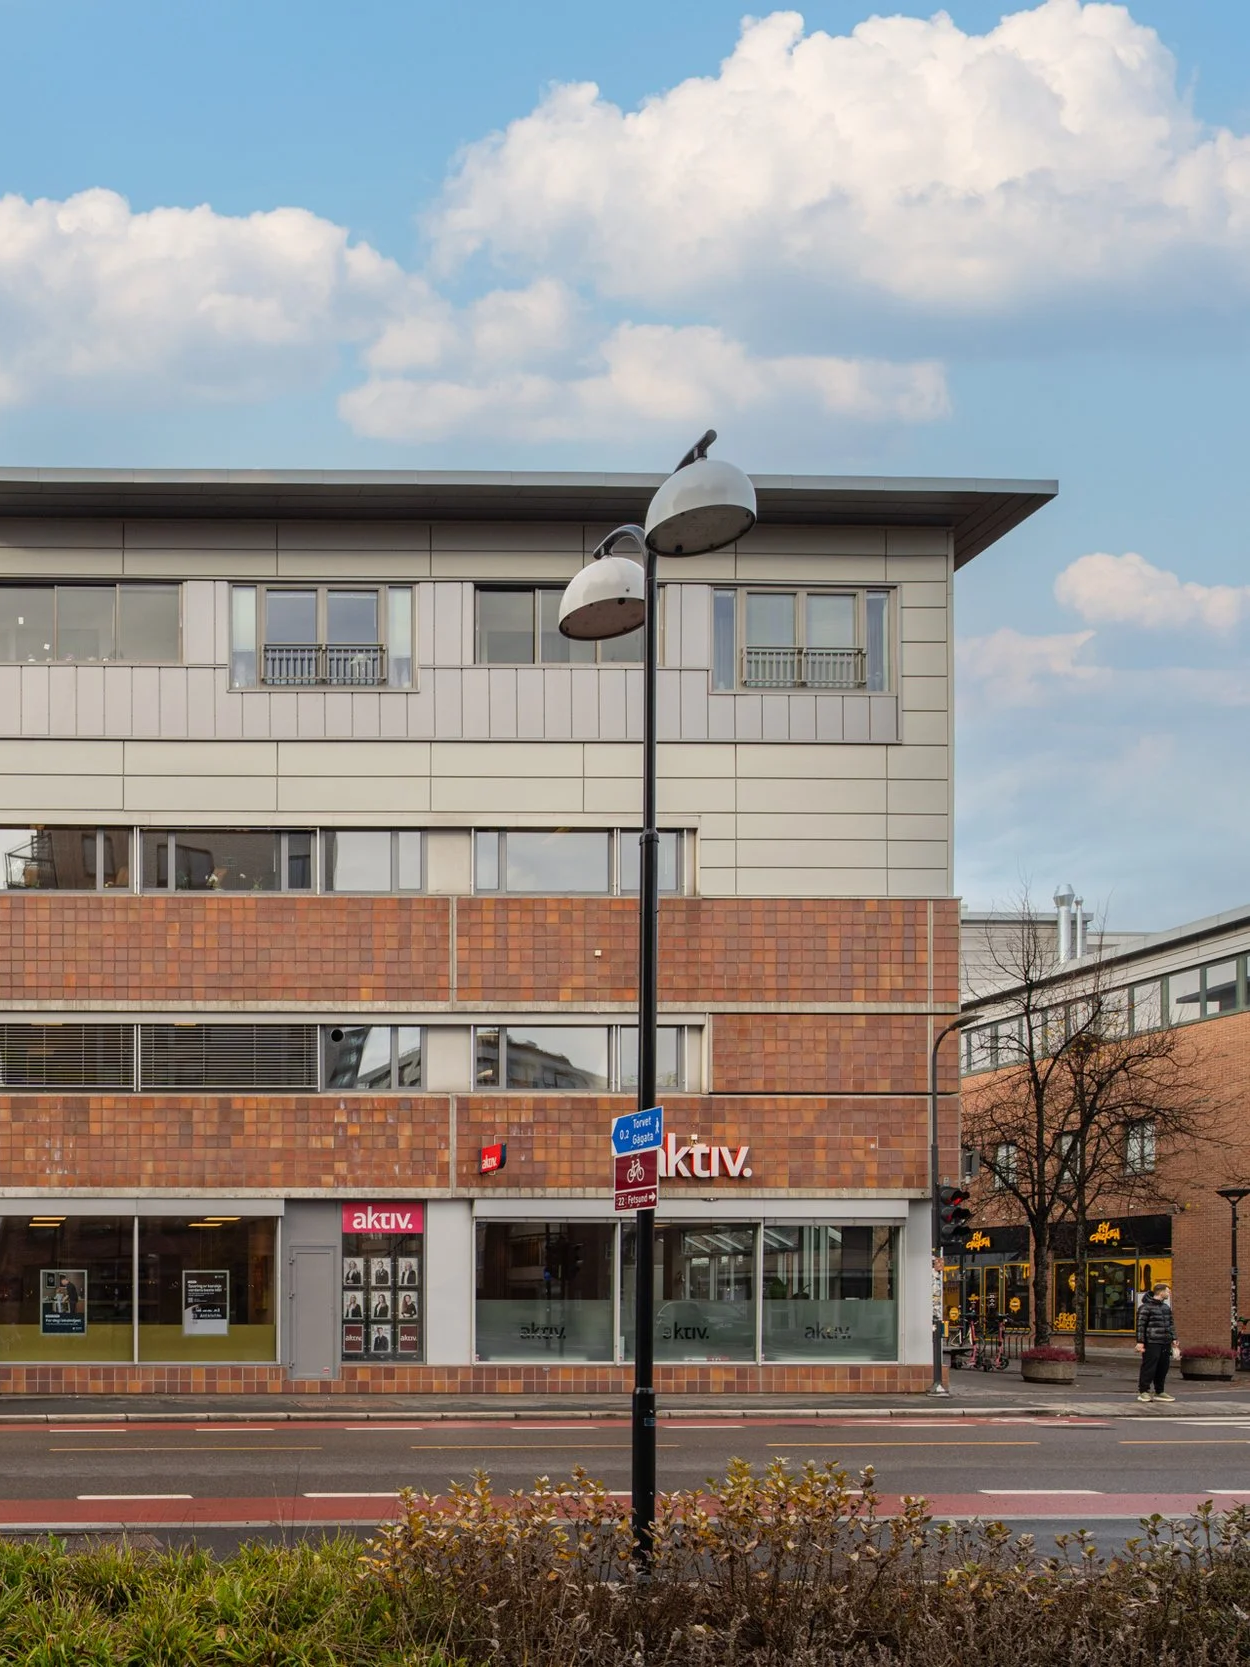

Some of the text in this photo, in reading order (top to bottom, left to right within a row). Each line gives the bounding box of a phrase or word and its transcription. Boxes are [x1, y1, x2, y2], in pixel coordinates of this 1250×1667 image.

[632, 1116, 652, 1129] Torvet
[632, 1132, 654, 1146] Gågata
[617, 1193, 648, 1207] 22 Fetsund
[352, 1206, 413, 1230] aktiv.
